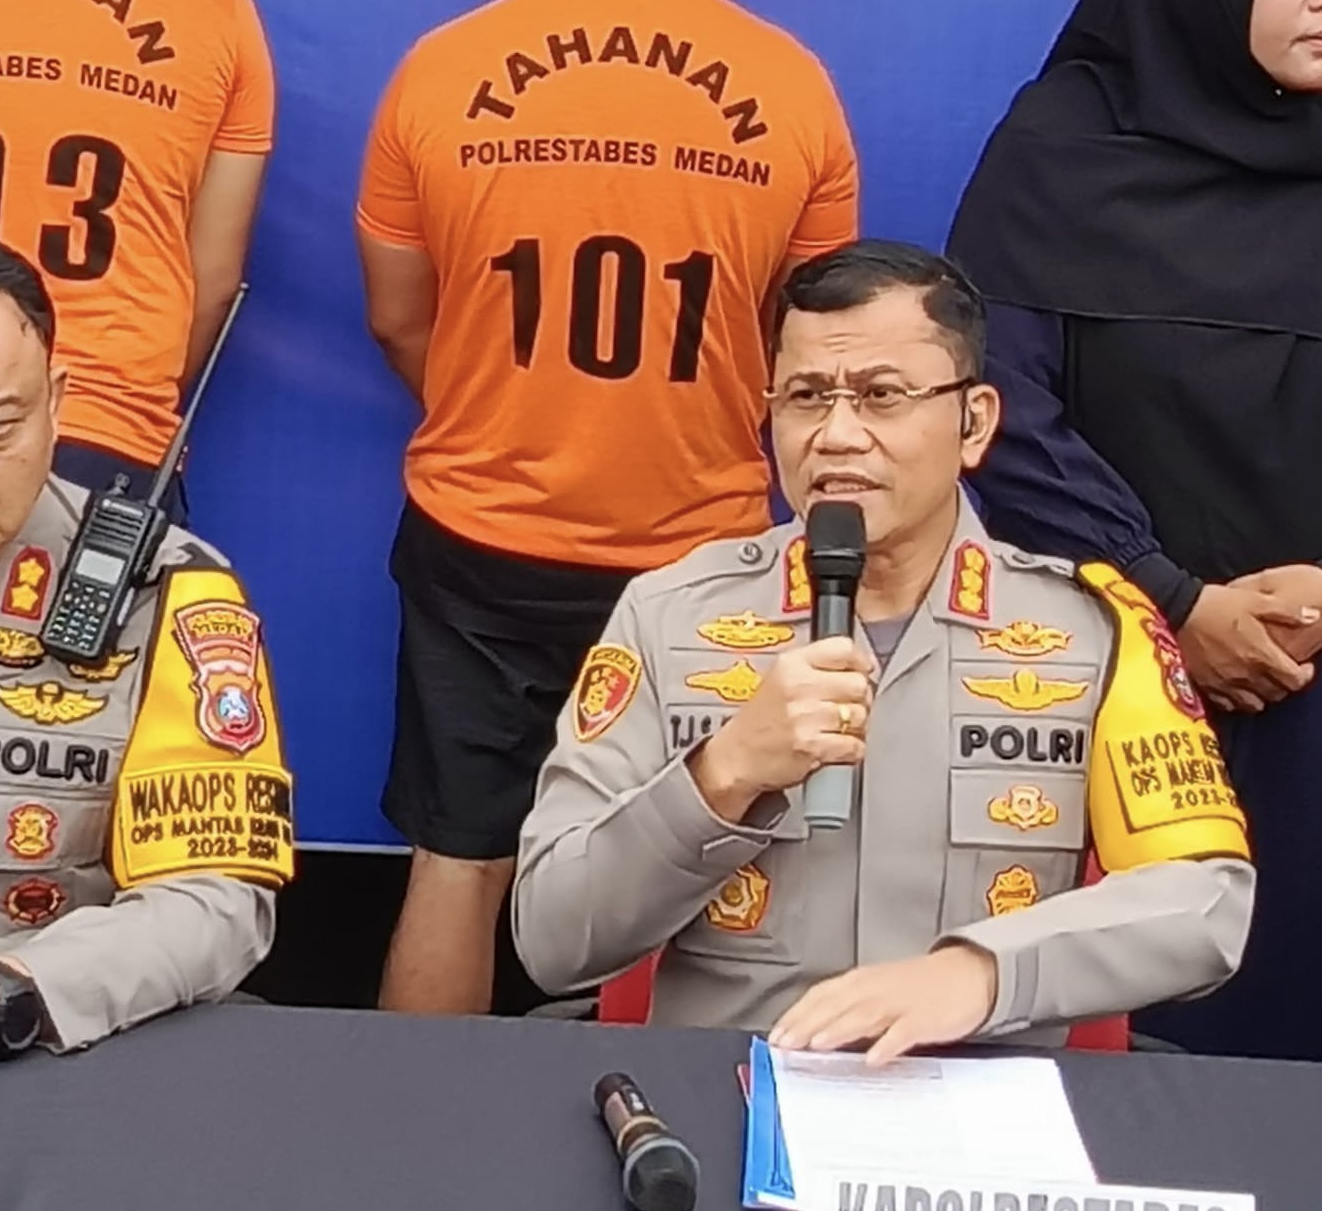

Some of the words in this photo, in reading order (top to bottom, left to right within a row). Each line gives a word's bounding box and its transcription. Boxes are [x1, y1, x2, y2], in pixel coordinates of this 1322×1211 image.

[80, 62, 177, 111] MEDAN
[466, 26, 769, 145] TAHANAN
[460, 137, 658, 168] POLRESTABES
[674, 146, 771, 187] MEDAN
[490, 234, 714, 383] 101
[960, 724, 1086, 764] POLRI
[1122, 730, 1195, 767] KAOPS
[129, 772, 237, 822] WAKAOPS
[131, 822, 164, 845] OPS
